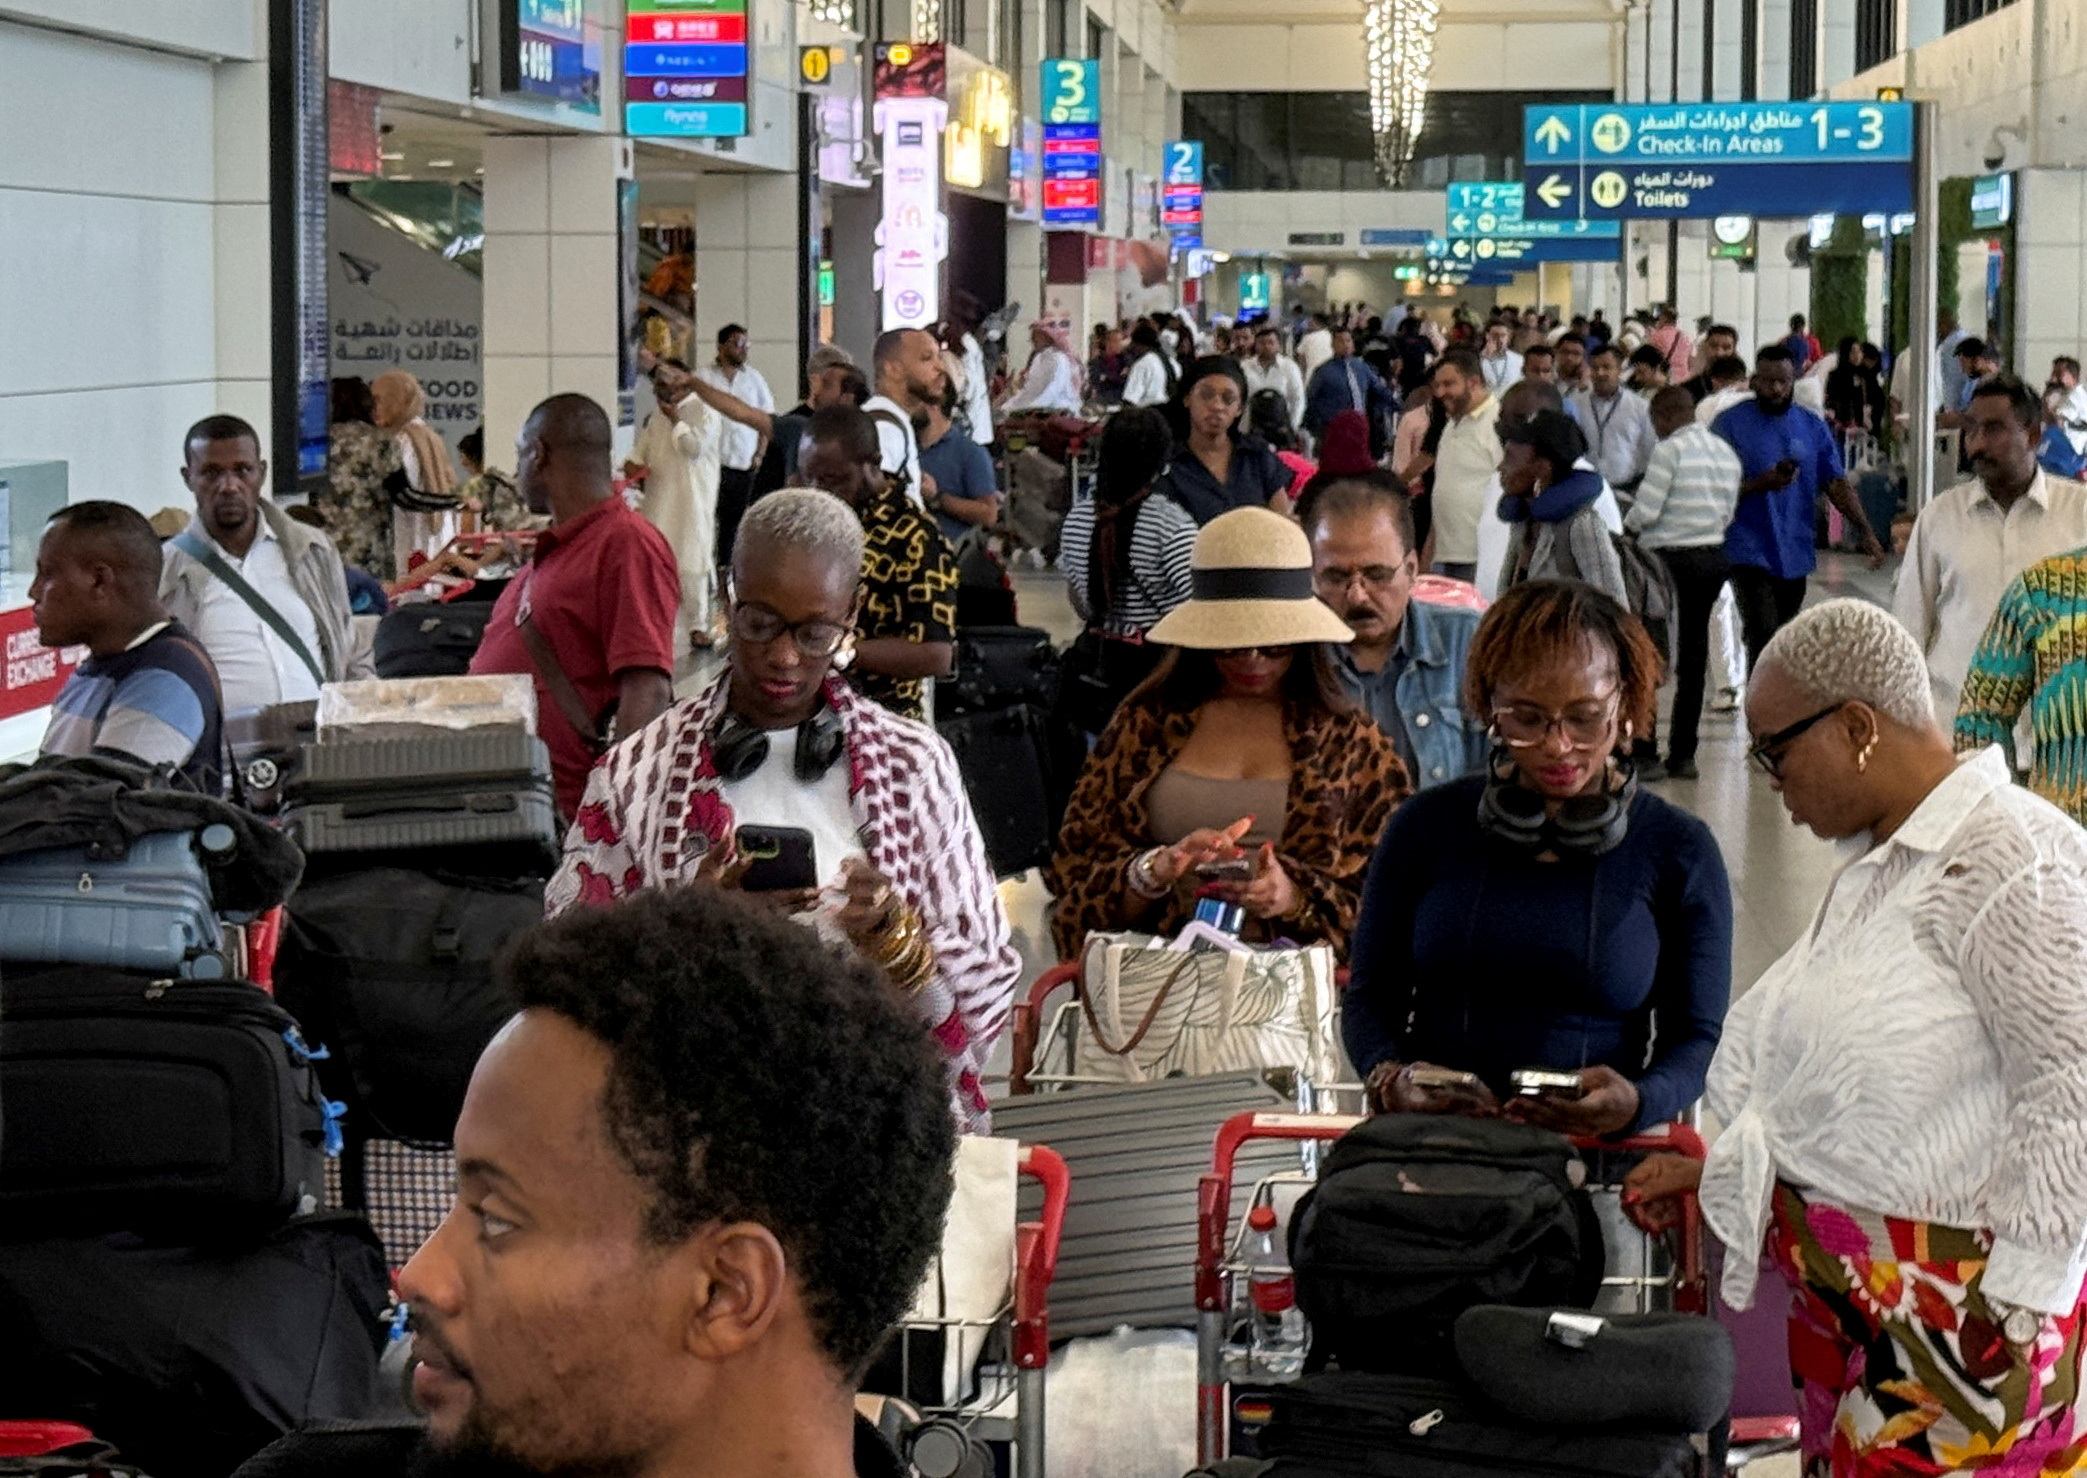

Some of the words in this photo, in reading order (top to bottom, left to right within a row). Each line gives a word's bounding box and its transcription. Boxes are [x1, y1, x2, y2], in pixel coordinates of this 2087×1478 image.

[1056, 60, 1086, 106] 3
[1637, 111, 1687, 134] السفر
[1750, 111, 1804, 134] مناطق
[1811, 107, 1884, 151] 1-3
[1637, 134, 1723, 155] Check-In
[1726, 134, 1784, 155] Areas
[1172, 143, 1194, 173] 2
[1633, 171, 1672, 188] المياه
[1672, 172, 1715, 189] دورات
[1634, 190, 1691, 208] Toilets
[1247, 274, 1260, 299] 1
[420, 380, 479, 398] OOD
